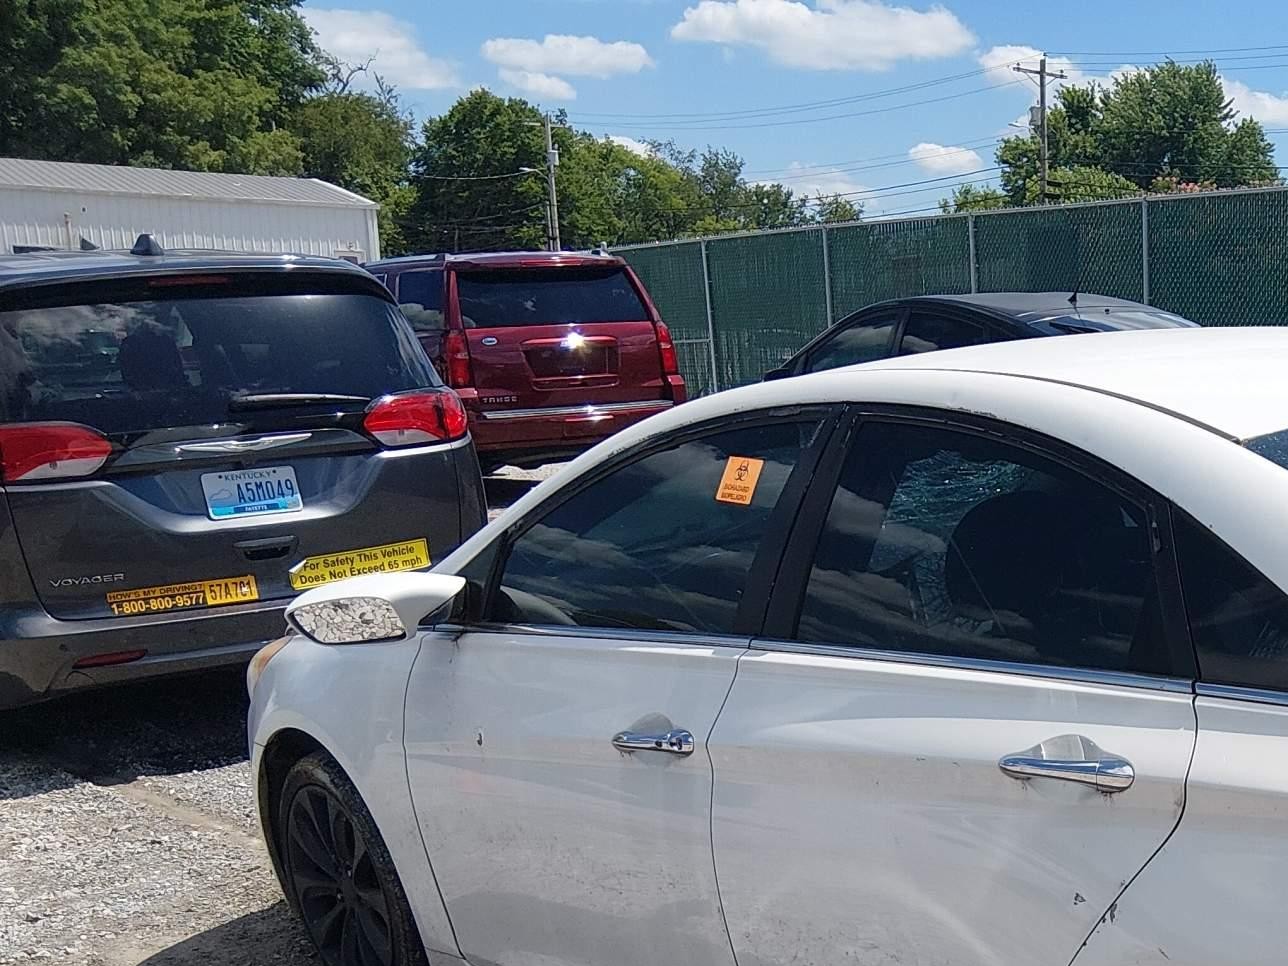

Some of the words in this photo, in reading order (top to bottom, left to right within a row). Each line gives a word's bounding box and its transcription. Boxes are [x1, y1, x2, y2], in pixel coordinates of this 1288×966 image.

[482, 395, 518, 403] TAHOE
[224, 470, 272, 481] KENTUCKY
[236, 478, 295, 504] A5M049
[303, 561, 320, 572] For
[323, 556, 355, 569] Safety
[356, 552, 379, 562] This
[380, 544, 415, 559] Vehicle
[300, 574, 326, 585] Does
[329, 570, 348, 580] Not
[350, 561, 386, 576] Exceed
[388, 560, 400, 570] 65
[401, 555, 423, 568] mph
[50, 573, 125, 588] VOYAGER
[108, 590, 142, 601] HOW'S
[143, 588, 158, 597] MY
[160, 583, 203, 595] DRIVING?
[111, 592, 205, 615] 1-800-800-9577
